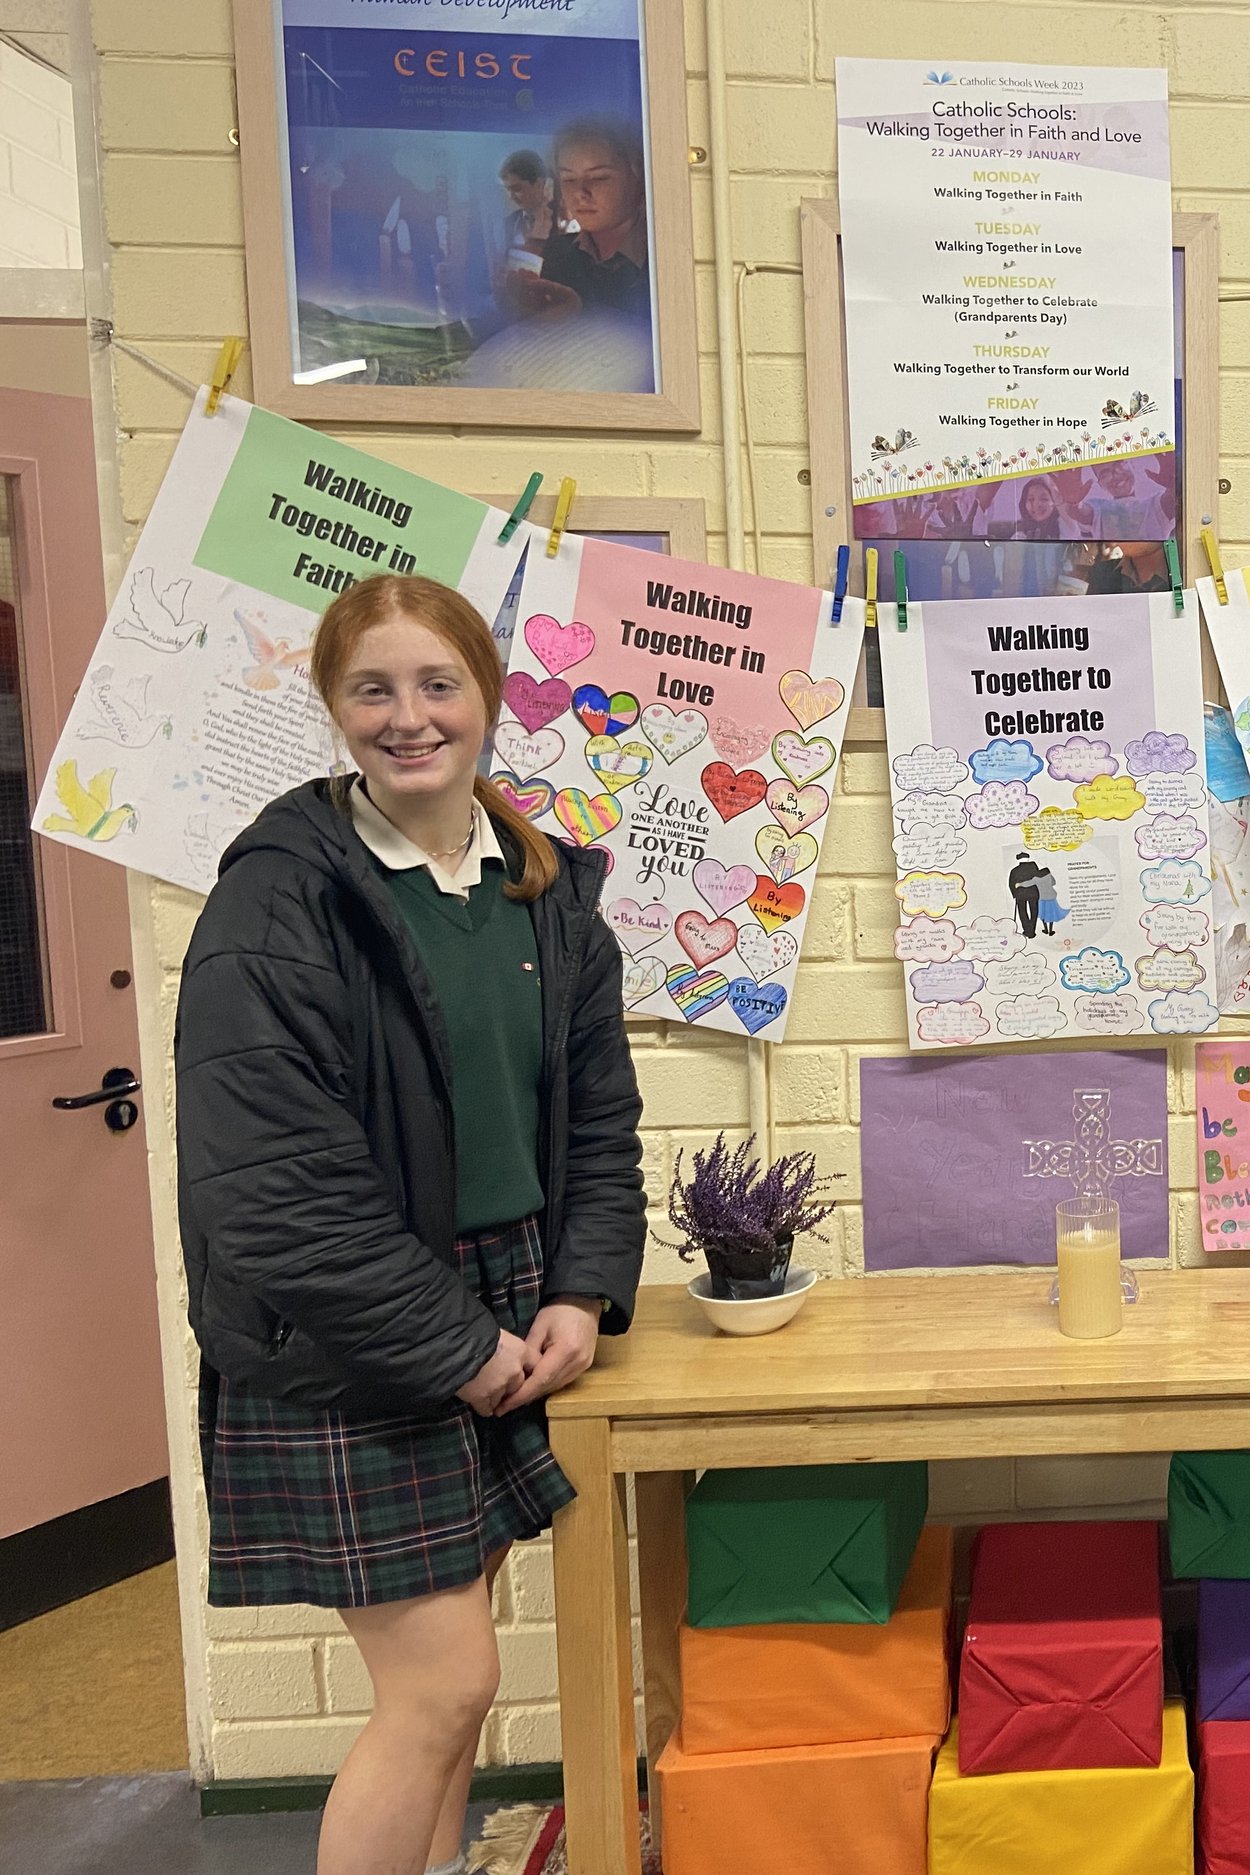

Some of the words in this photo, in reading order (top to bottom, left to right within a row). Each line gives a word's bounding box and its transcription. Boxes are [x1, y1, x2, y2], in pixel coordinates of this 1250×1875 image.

[393, 49, 532, 80] CEIST
[959, 76, 997, 87] Catholic
[999, 78, 1033, 87] Schools
[1034, 79, 1060, 89] Week
[1061, 81, 1084, 90] 2023
[932, 101, 1002, 117] Catholic
[1007, 102, 1077, 120] Schools:
[866, 122, 930, 141] Walking
[934, 123, 1006, 142] Together
[1010, 124, 1024, 138] in
[1028, 124, 1067, 140] Faith
[1071, 125, 1100, 141] and
[1105, 127, 1142, 143] Love
[931, 148, 945, 157] 22
[1027, 151, 1081, 161] JANUARY
[973, 170, 1040, 184] MONDAY
[934, 187, 982, 201] Walking
[985, 188, 1038, 202] Together
[1041, 189, 1051, 200] in
[1055, 190, 1083, 202] Faith
[975, 222, 1041, 236] TUESDAY
[935, 241, 984, 255] Walking
[986, 242, 1038, 255] Together
[1041, 242, 1051, 253] in
[1055, 243, 1082, 255] Love
[963, 276, 1057, 289] WEDNESDAY
[922, 294, 970, 308] Walking
[973, 295, 1024, 309] Together
[1027, 297, 1039, 307] to
[1042, 296, 1098, 308] Celebrate
[954, 311, 1038, 325] (Grandparents
[1040, 312, 1067, 326] Day)
[973, 345, 1050, 358] THURSDAY
[893, 362, 941, 376] Walking
[944, 363, 996, 377] Together
[999, 365, 1010, 375] to
[1013, 364, 1070, 377] Transform
[1073, 368, 1092, 377] our
[1094, 365, 1129, 377] World
[987, 398, 1039, 410] FRIDAY
[938, 415, 986, 429] Walking
[989, 416, 1040, 429] Together
[1043, 416, 1054, 427] in
[1056, 417, 1087, 429] Hope
[303, 459, 414, 529] Walking
[267, 493, 388, 564] Together
[387, 544, 417, 576] in
[646, 580, 753, 630] Walking
[620, 619, 737, 671] Together
[739, 645, 766, 674] in
[987, 624, 1090, 652] Walking
[656, 672, 715, 707] Love
[971, 667, 1082, 697] Together
[1087, 667, 1111, 690] to
[985, 709, 1104, 737] Celebrate
[634, 781, 710, 823] Love
[787, 793, 798, 809] By
[770, 803, 807, 822] Listening
[631, 812, 655, 824] ONE
[656, 818, 710, 836] ANOTHER
[651, 827, 661, 835] AS
[663, 828, 667, 836] I
[668, 829, 686, 840] HAVE
[627, 832, 705, 861] LOVED
[636, 855, 690, 901] you
[767, 891, 782, 906] By
[620, 912, 636, 925] Be
[637, 916, 662, 931] Kind
[753, 903, 792, 922] Listening
[736, 984, 747, 993] BE
[733, 995, 785, 1015] POSITIVE
[1202, 1107, 1237, 1139] be
